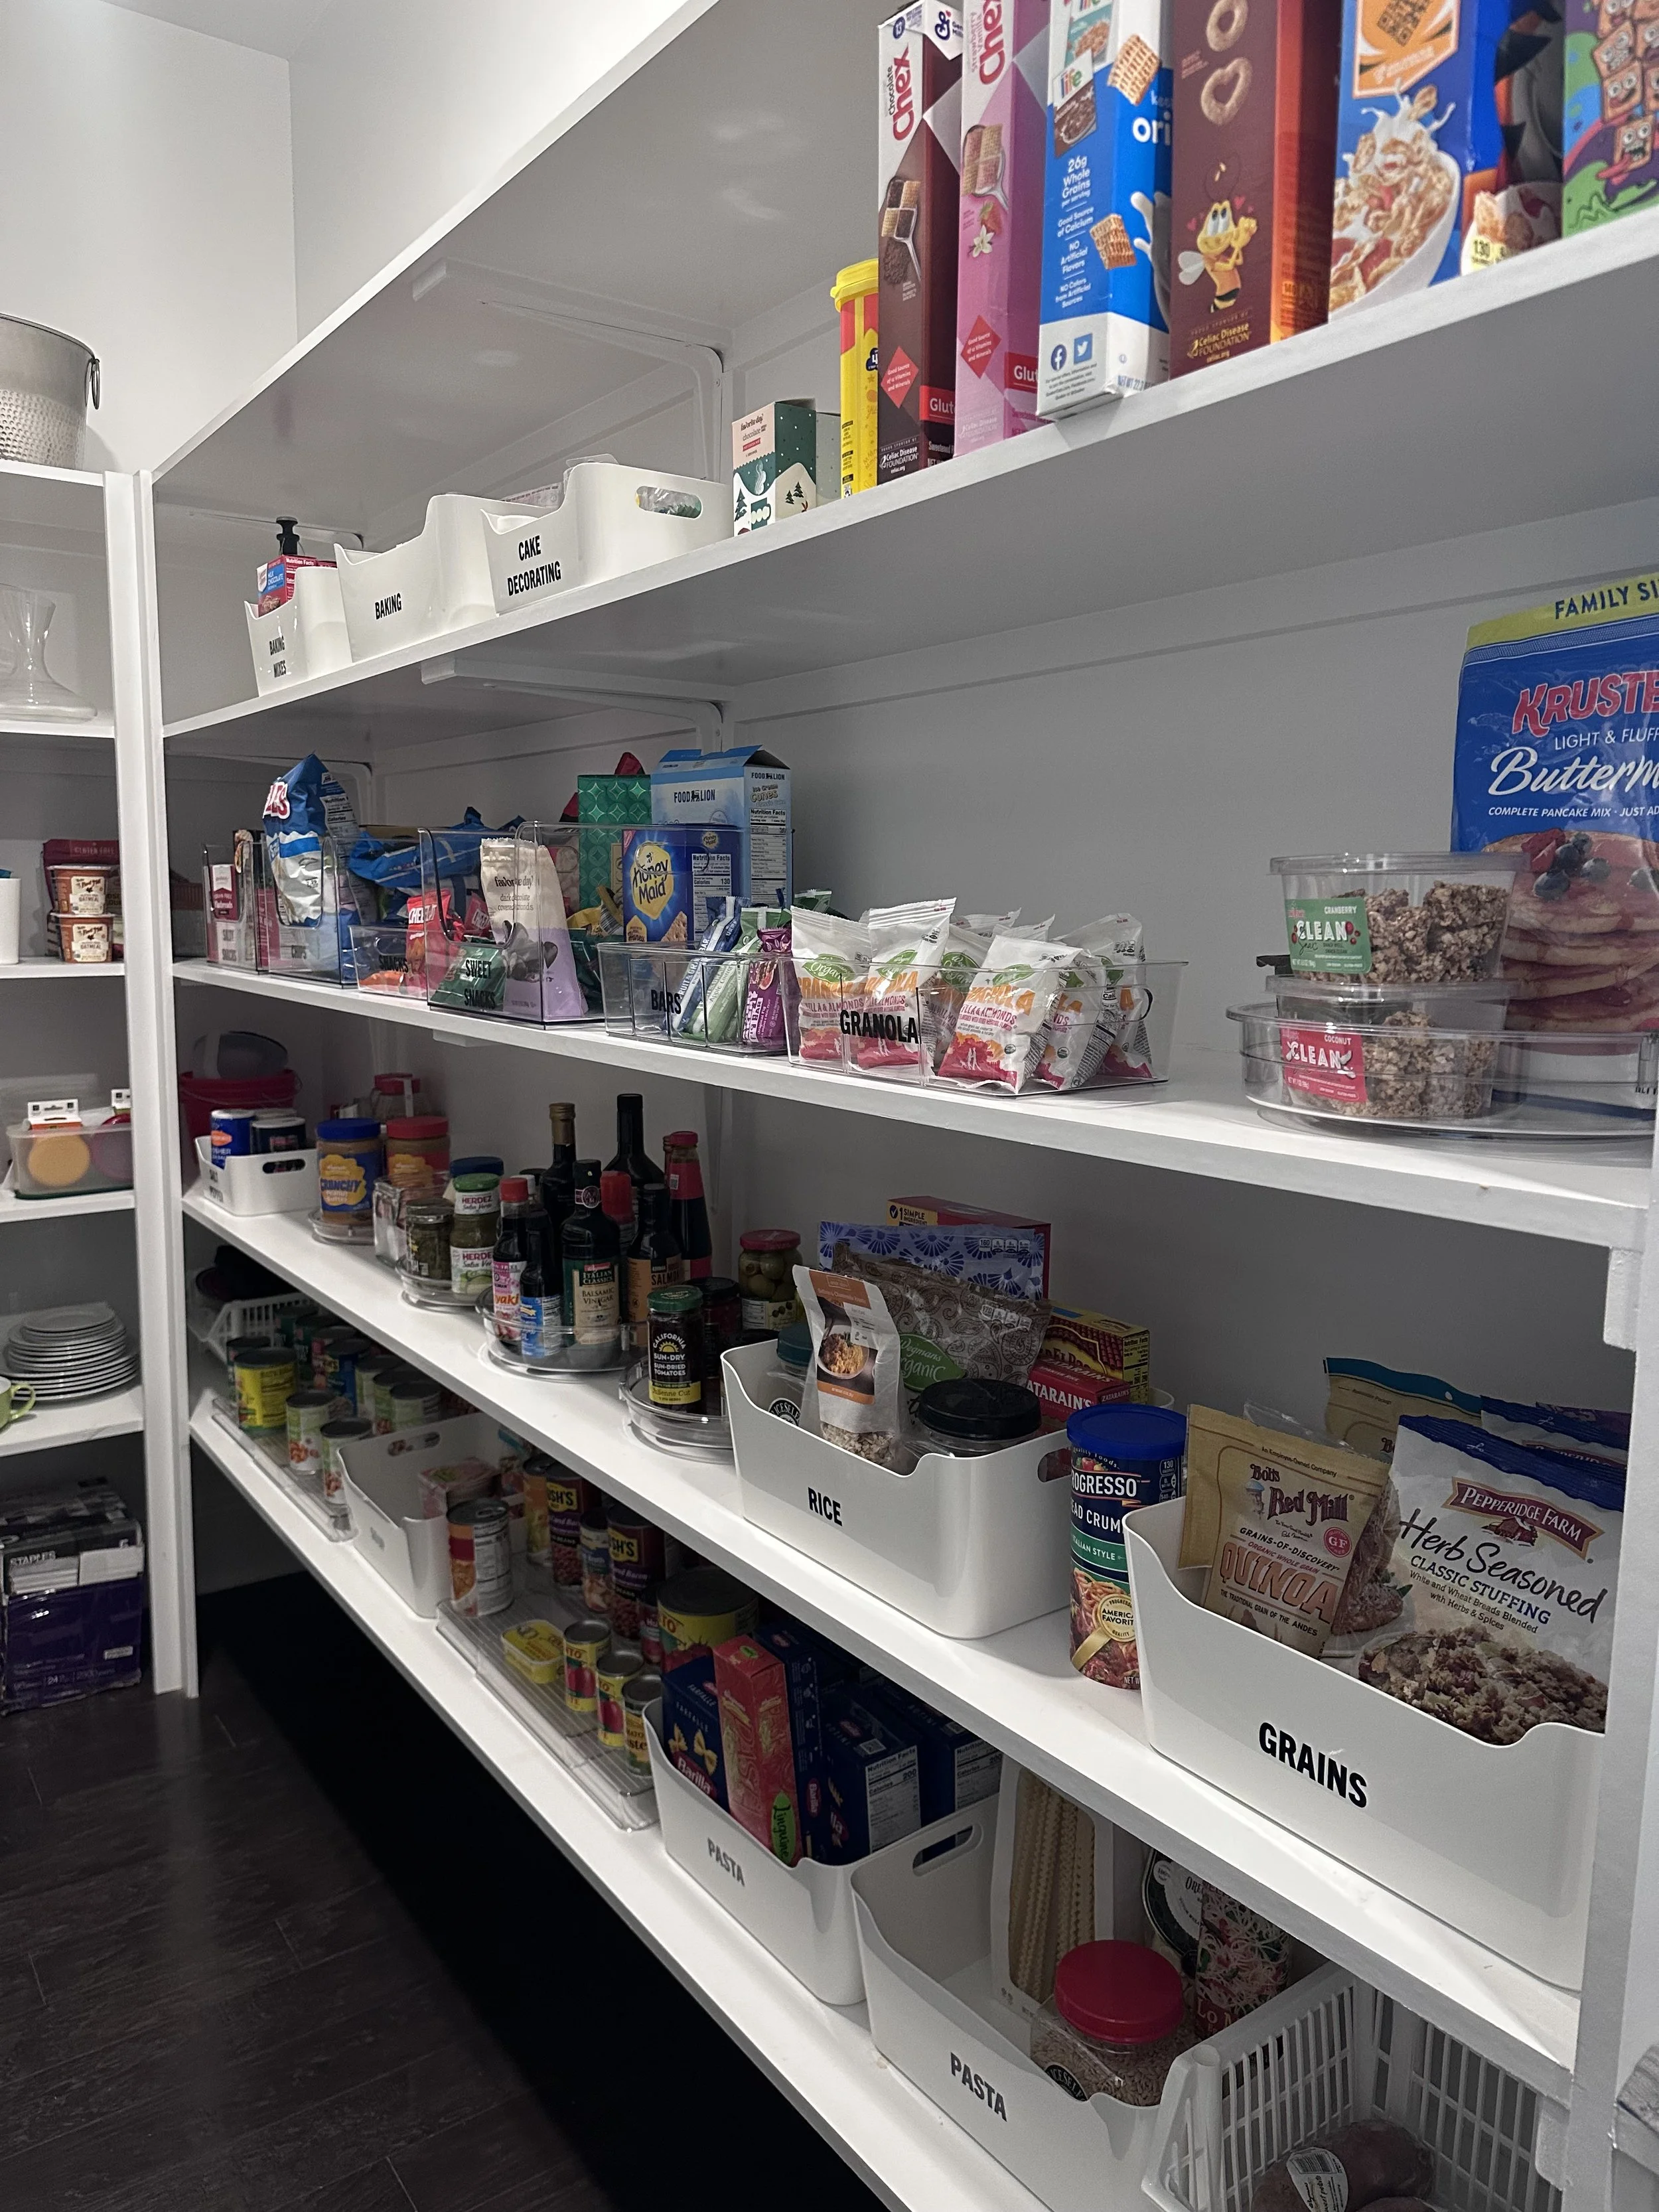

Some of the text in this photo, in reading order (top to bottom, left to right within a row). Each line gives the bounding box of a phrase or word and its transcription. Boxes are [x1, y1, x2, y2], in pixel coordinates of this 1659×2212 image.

[892, 42, 914, 141] Chex
[1060, 69, 1082, 98] life
[1067, 156, 1088, 173] 26g
[1062, 169, 1090, 187] Whole
[1062, 179, 1091, 199] Grains
[1057, 216, 1094, 238] of Calcium
[1058, 206, 1094, 228] Good Source
[1060, 246, 1088, 266] Artificial
[1069, 240, 1080, 252] NO
[1062, 259, 1085, 274] Flavors
[1062, 295, 1084, 309] Sources
[1198, 334, 1220, 347] Celiac
[1220, 322, 1250, 338] Disease
[1198, 332, 1251, 357] FOUNDATION
[886, 449, 899, 461] Celiac
[899, 446, 918, 457] Disease
[886, 453, 918, 468] FOUNDATION
[518, 535, 541, 561] CAKE
[507, 561, 561, 597] DECORATING
[374, 593, 403, 621] BAKING
[1555, 585, 1629, 620] FAMILY
[269, 635, 285, 656] BAKING
[1555, 731, 1600, 751] LIGHT
[1605, 729, 1617, 744] &
[751, 771, 766, 780] FOOD
[674, 788, 716, 804] FOOD LION
[750, 790, 779, 803] Cones
[1488, 806, 1644, 818] COMPLETE PANCAKE MIX JUST
[633, 859, 669, 888] Honey
[638, 879, 666, 905] Maid
[1324, 906, 1358, 915] CRANBERRY
[1296, 920, 1348, 941] CLEAN
[379, 955, 409, 974] SNACKS
[465, 959, 492, 980] SWEET
[464, 988, 496, 1009] SNACKS
[651, 989, 682, 1015] BARS
[840, 1009, 920, 1044] GRANOLA
[1324, 1034, 1352, 1046] COCONUT
[1290, 1041, 1342, 1070] CLEAN
[320, 1178, 362, 1192] CRUNCHY
[461, 1195, 492, 1205] HERDEZ
[903, 1208, 926, 1220] SIMPLE
[462, 1252, 493, 1262] HERDE
[583, 1270, 613, 1280] ITALIAN
[583, 1276, 614, 1285] CLASSICS
[582, 1286, 616, 1298] BALSAMIC
[653, 1333, 687, 1350] CALIFORNIA
[901, 1338, 943, 1363] Wegmans
[654, 1368, 686, 1376] TOMATOES
[901, 1358, 946, 1382] rganic
[1101, 1388, 1130, 1403] ZATARAIN'S
[1163, 1460, 1175, 1469] 130
[1250, 1463, 1281, 1483] Bob's
[1310, 1463, 1338, 1479] Company
[808, 1487, 843, 1527] RICE
[1267, 1485, 1350, 1527] Red Mill
[1459, 1486, 1583, 1543] PEPPERIDGE FARM
[1328, 1536, 1348, 1549] GF
[1092, 1546, 1116, 1562] STYLE
[1247, 1540, 1320, 1575] ORGANIC WHOLE GRAIN
[1398, 1507, 1609, 1625] Herb Seasoned
[1218, 1541, 1340, 1624] QUINOA
[1410, 1554, 1552, 1626] CLASSIC STUFFING
[1409, 1570, 1540, 1635] White and Wheat Breads Blended
[1429, 1591, 1505, 1633] with Herbs & Spices
[1228, 1591, 1254, 1611] TRADITIONAL
[1254, 1601, 1269, 1615] GRAIN
[1269, 1609, 1277, 1618] OF
[1278, 1613, 1289, 1625] THE
[1291, 1619, 1319, 1637] ANDES
[1112, 1629, 1131, 1638] QUALITY
[867, 1747, 916, 1773] Nutrition Facts
[1259, 1722, 1368, 1808] GRAINS
[677, 1756, 713, 1796] Barilla
[902, 1768, 918, 1781] 200
[772, 1803, 791, 1859] Linguine
[707, 1837, 746, 1887] PASTA
[950, 2051, 1009, 2123] PASTA
